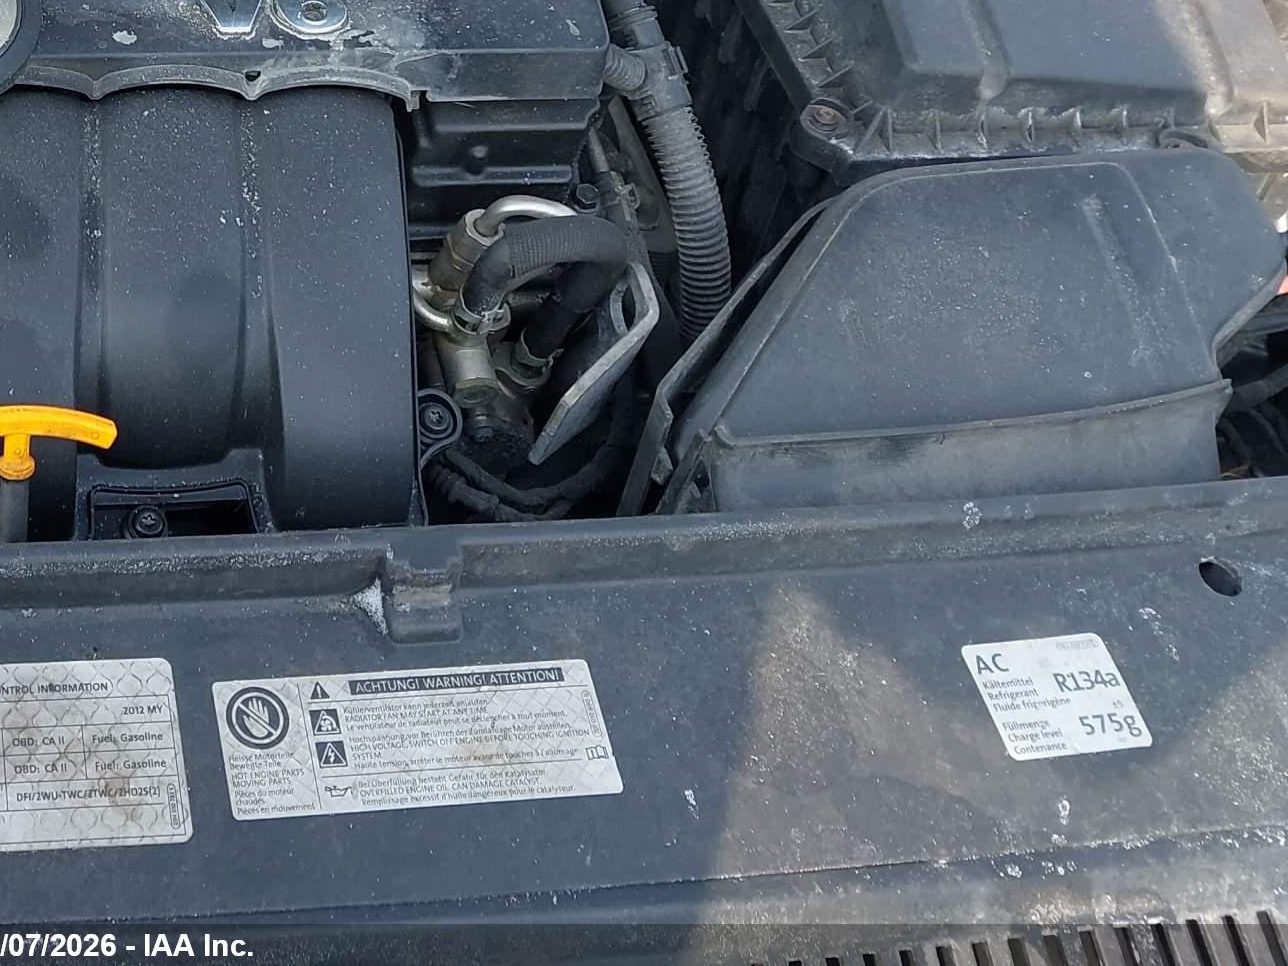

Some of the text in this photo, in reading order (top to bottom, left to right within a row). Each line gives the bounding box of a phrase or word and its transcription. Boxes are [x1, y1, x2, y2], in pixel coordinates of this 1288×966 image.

[975, 653, 1008, 674] AC
[354, 669, 559, 693] ACHTUNG! WARNING! ATTENTION!
[1053, 669, 1119, 691] R134a
[37, 682, 107, 693] INFORMATION
[987, 688, 1038, 700] Refrigerant
[122, 704, 162, 714] 2012 MY
[1079, 712, 1141, 736] 575g
[12, 737, 37, 746] OBD:
[41, 736, 56, 745] CA
[92, 732, 162, 743] Fuel: Gasoline
[1014, 742, 1066, 754] Contenance
[13, 764, 39, 774] OBD:
[44, 762, 58, 773] CA
[95, 758, 166, 771] Fuel: Gasoline
